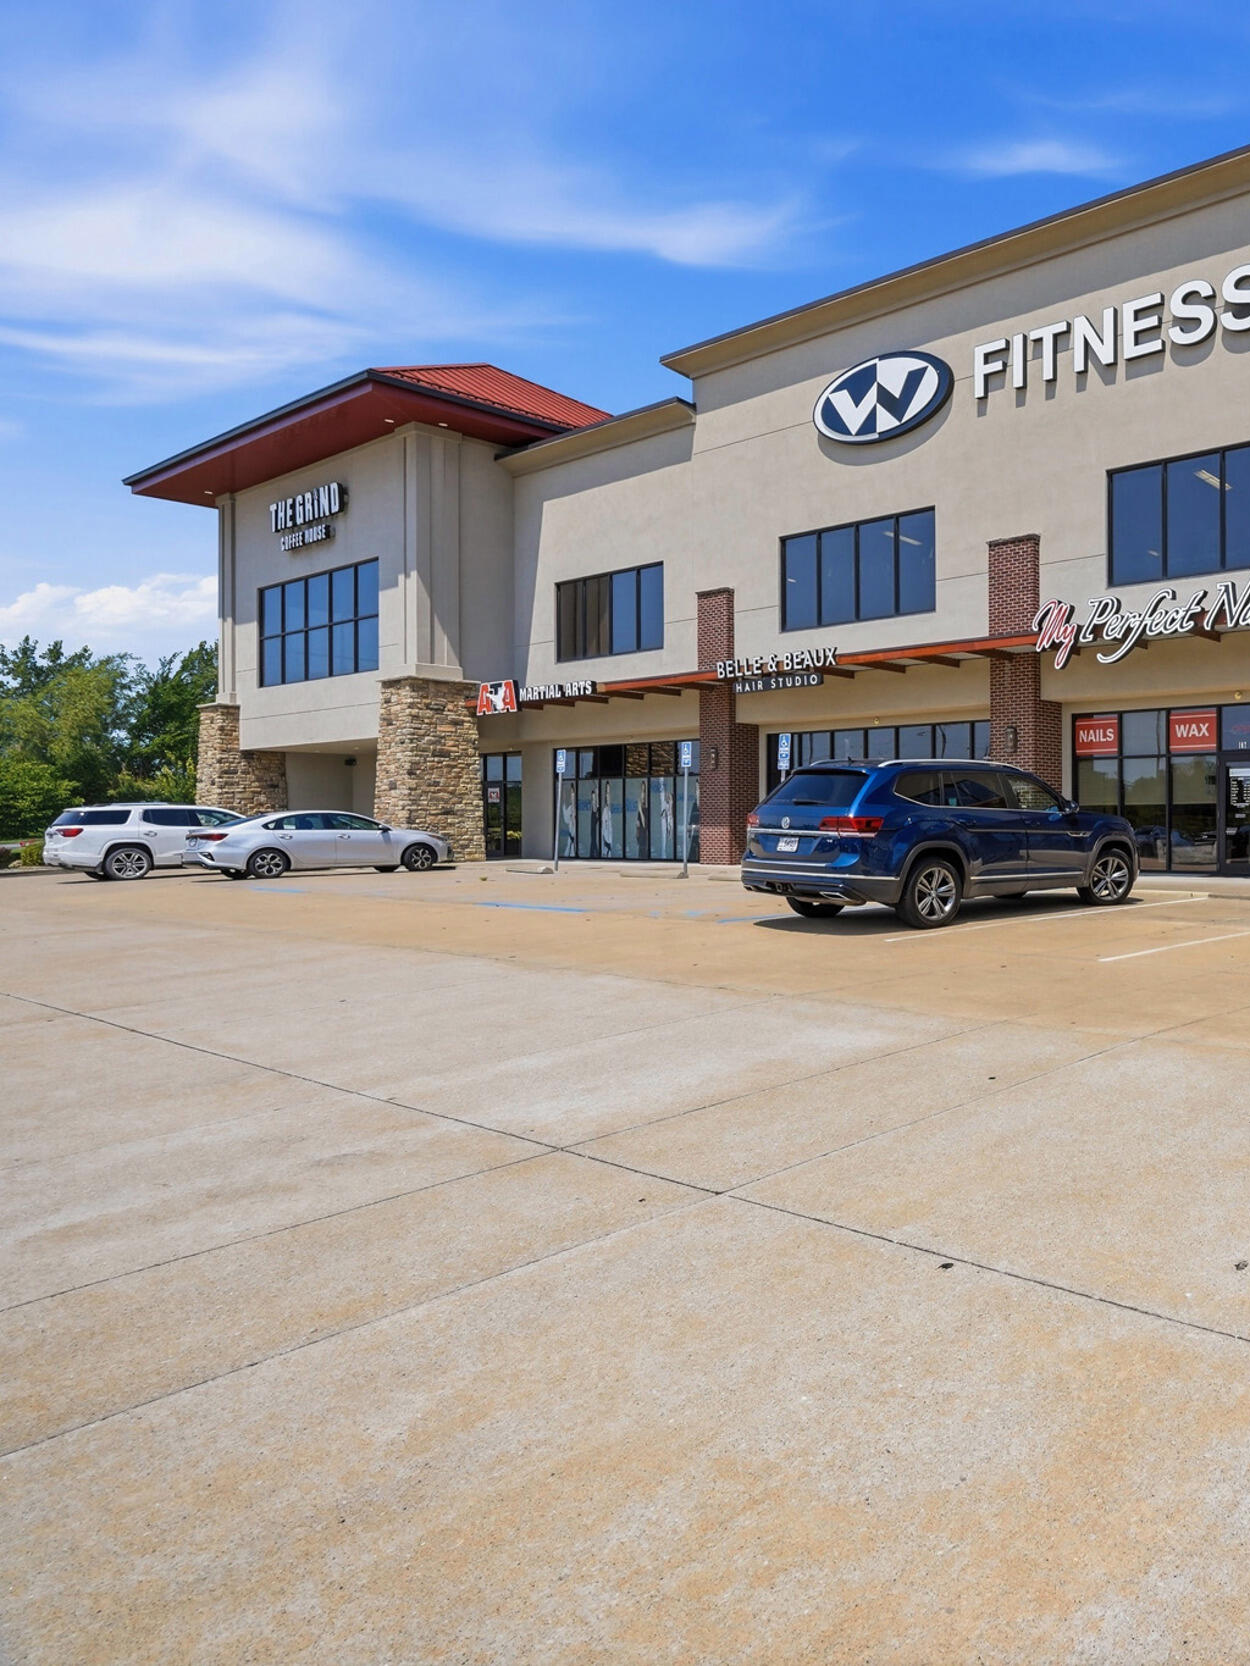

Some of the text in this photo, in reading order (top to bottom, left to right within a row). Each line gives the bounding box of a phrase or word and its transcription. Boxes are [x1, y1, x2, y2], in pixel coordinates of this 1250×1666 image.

[269, 497, 294, 533] THE
[281, 524, 327, 552] COFFEE HOUSE
[1033, 599, 1076, 669] My
[1080, 587, 1208, 664] Perfect
[716, 646, 837, 680] BELLE & BEAUX
[519, 680, 593, 702] MARTIAL ARTS
[735, 674, 818, 693] HAIR STUDIO
[477, 680, 518, 716] ATA
[1079, 728, 1115, 743] NAILS
[1174, 723, 1210, 738] WAX
